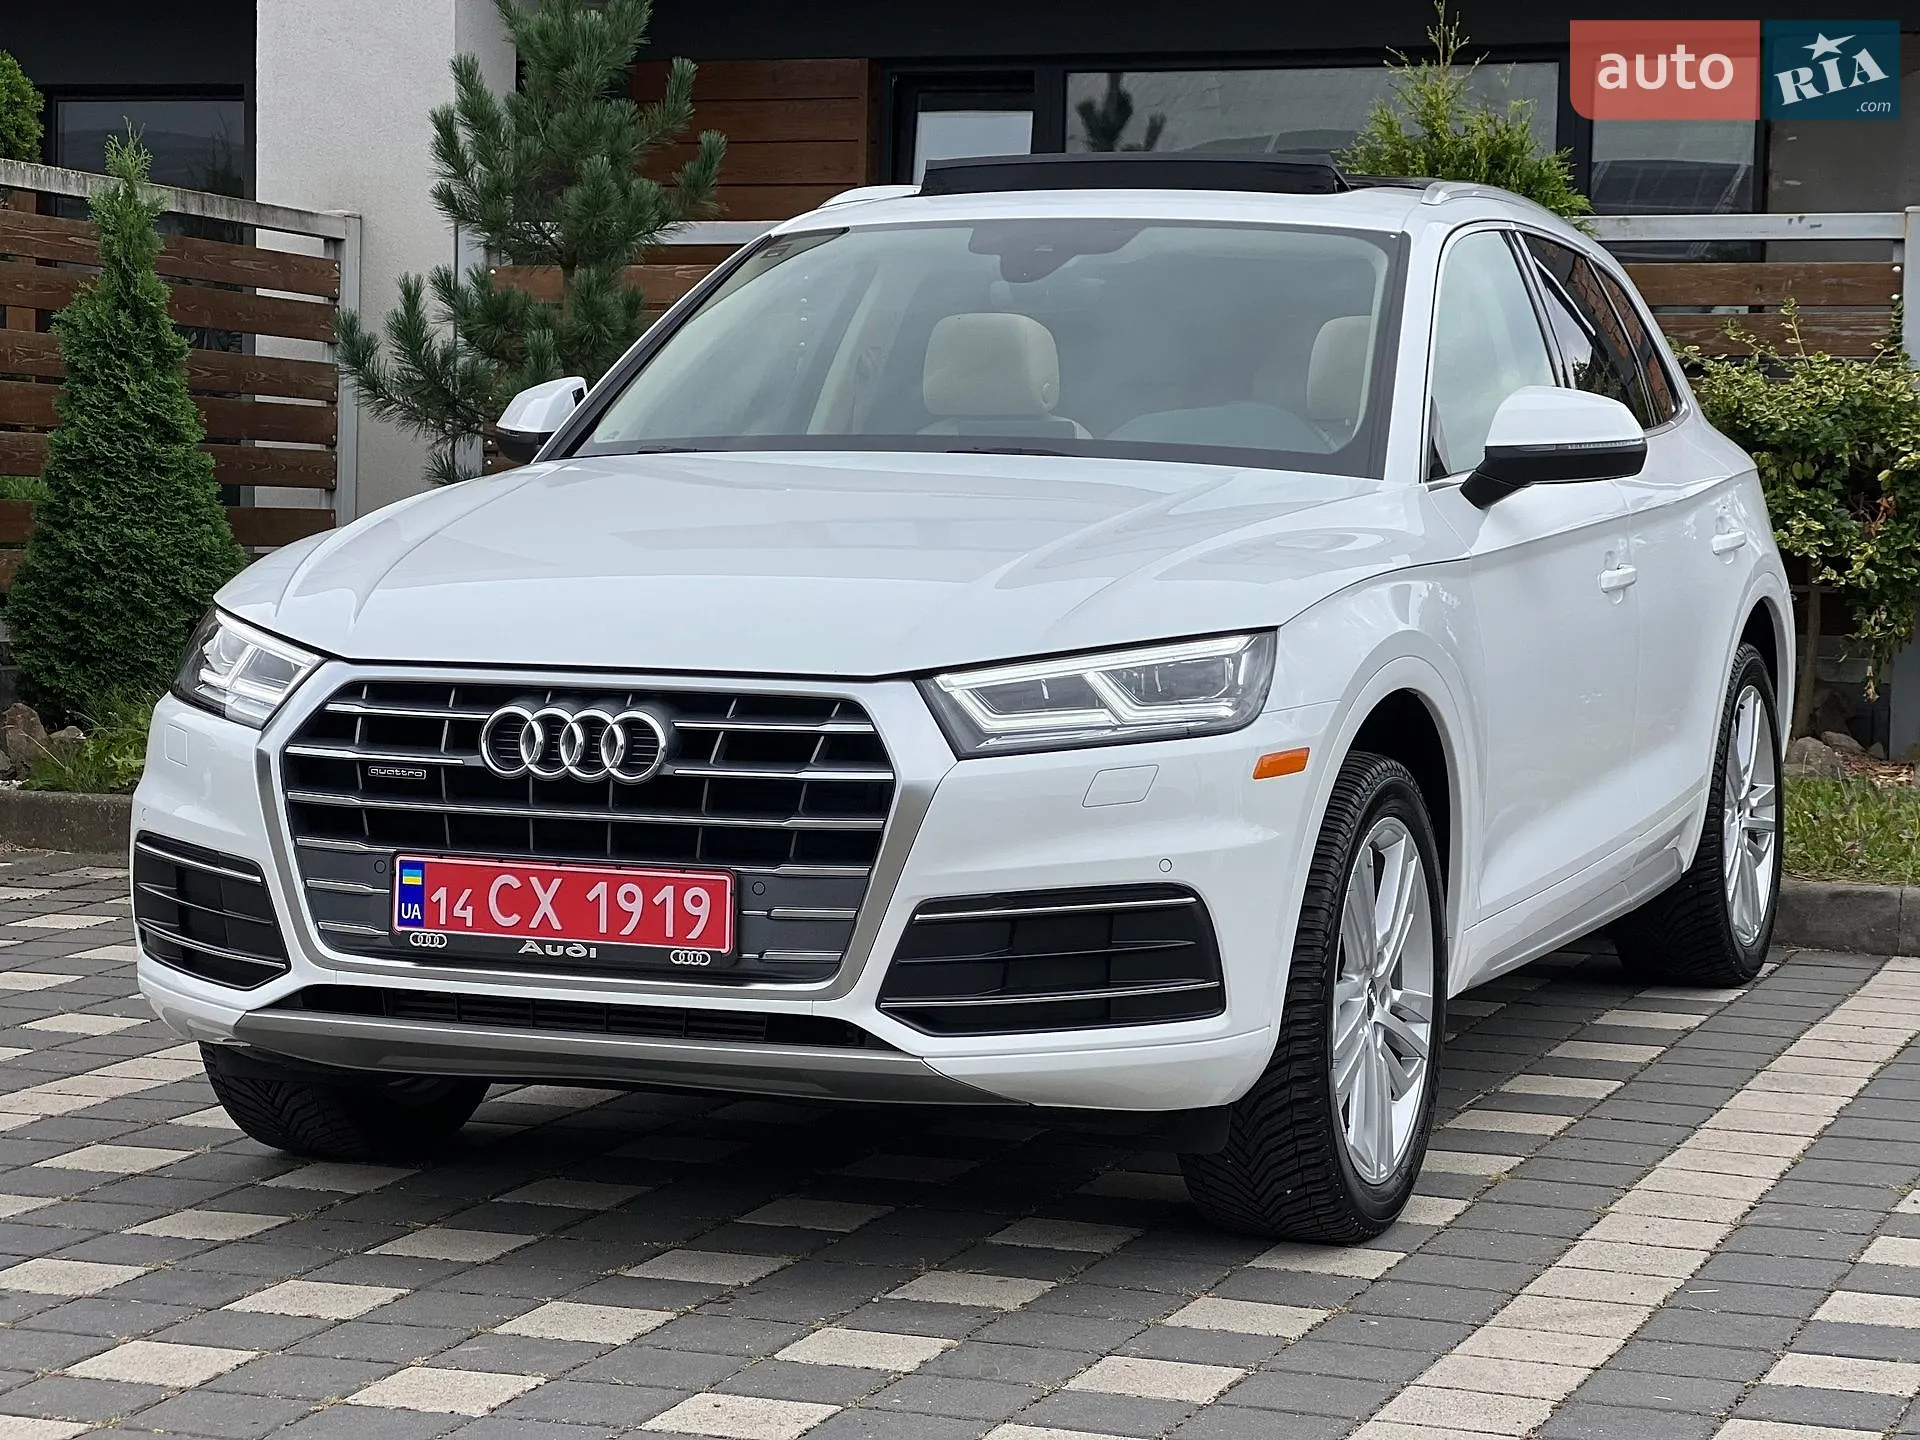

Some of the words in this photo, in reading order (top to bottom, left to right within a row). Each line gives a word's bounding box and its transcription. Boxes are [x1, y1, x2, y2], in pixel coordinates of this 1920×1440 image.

[370, 768, 423, 777] quattro
[401, 902, 422, 920] UA
[430, 886, 473, 927] 14
[488, 874, 564, 930] CX
[585, 881, 711, 940] 1919
[518, 940, 597, 959] Audi
